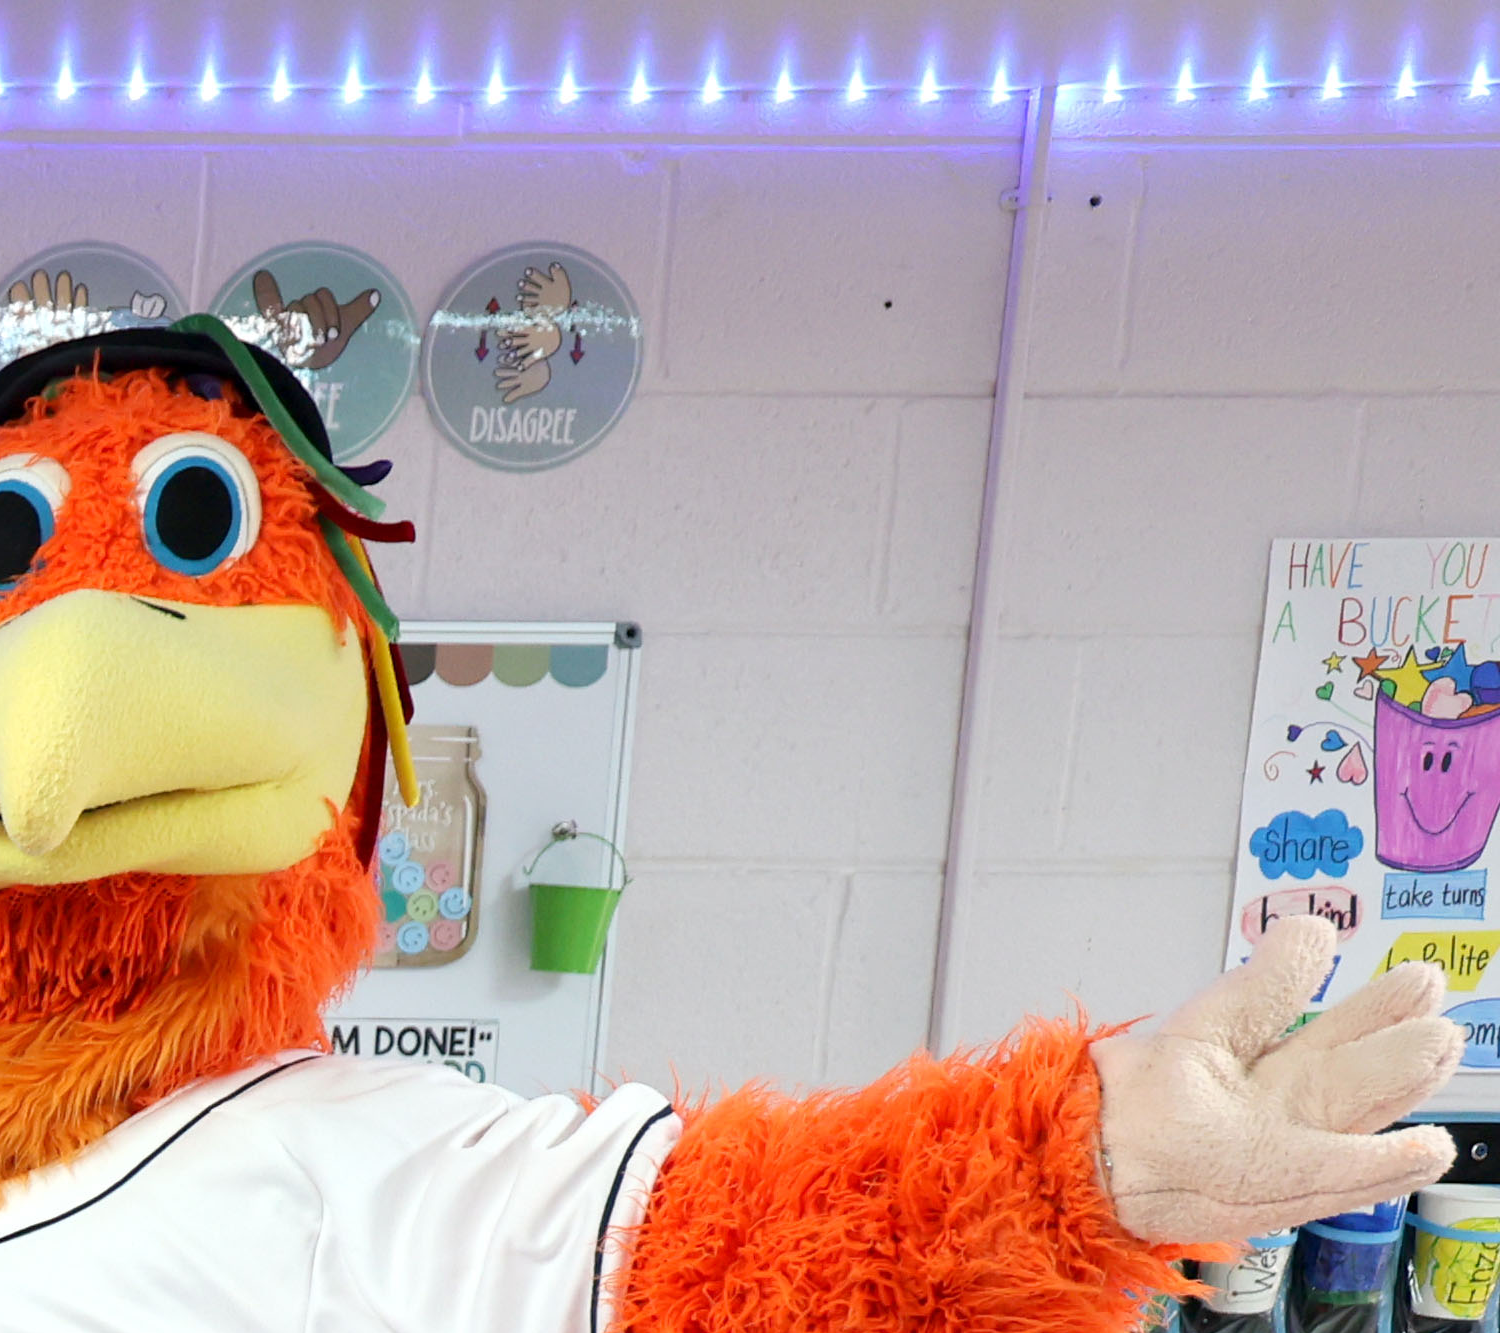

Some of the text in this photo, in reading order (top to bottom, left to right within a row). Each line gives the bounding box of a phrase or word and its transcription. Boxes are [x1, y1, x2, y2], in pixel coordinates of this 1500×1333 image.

[469, 406, 578, 446] DISAGREE
[1287, 542, 1490, 590] HAVE YOU
[1272, 593, 1500, 647] A BUCKET
[385, 799, 453, 830] spada's
[1263, 817, 1350, 864] share
[1386, 878, 1486, 910] take turns
